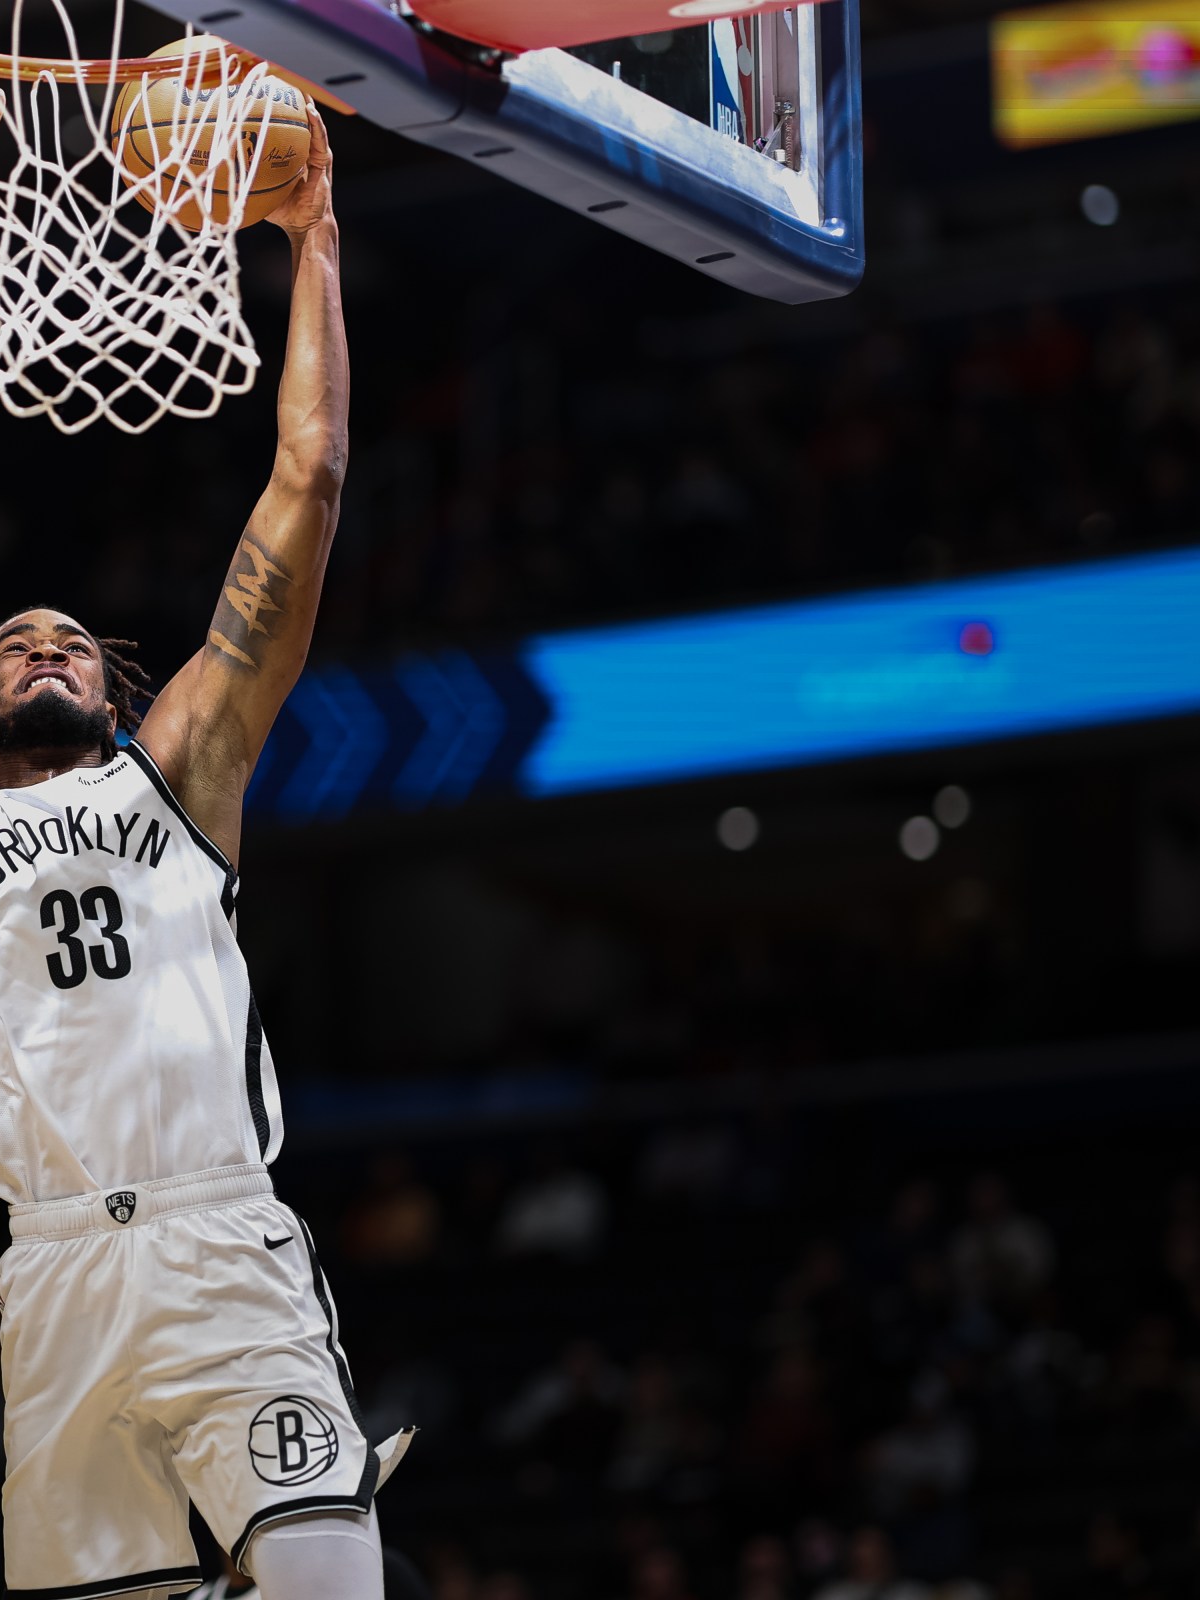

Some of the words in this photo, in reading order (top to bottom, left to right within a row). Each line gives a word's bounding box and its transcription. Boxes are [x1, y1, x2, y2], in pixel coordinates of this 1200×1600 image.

[717, 102, 739, 142] NBA
[40, 885, 131, 989] 33
[107, 1193, 135, 1210] NETS
[276, 1410, 308, 1473] B
